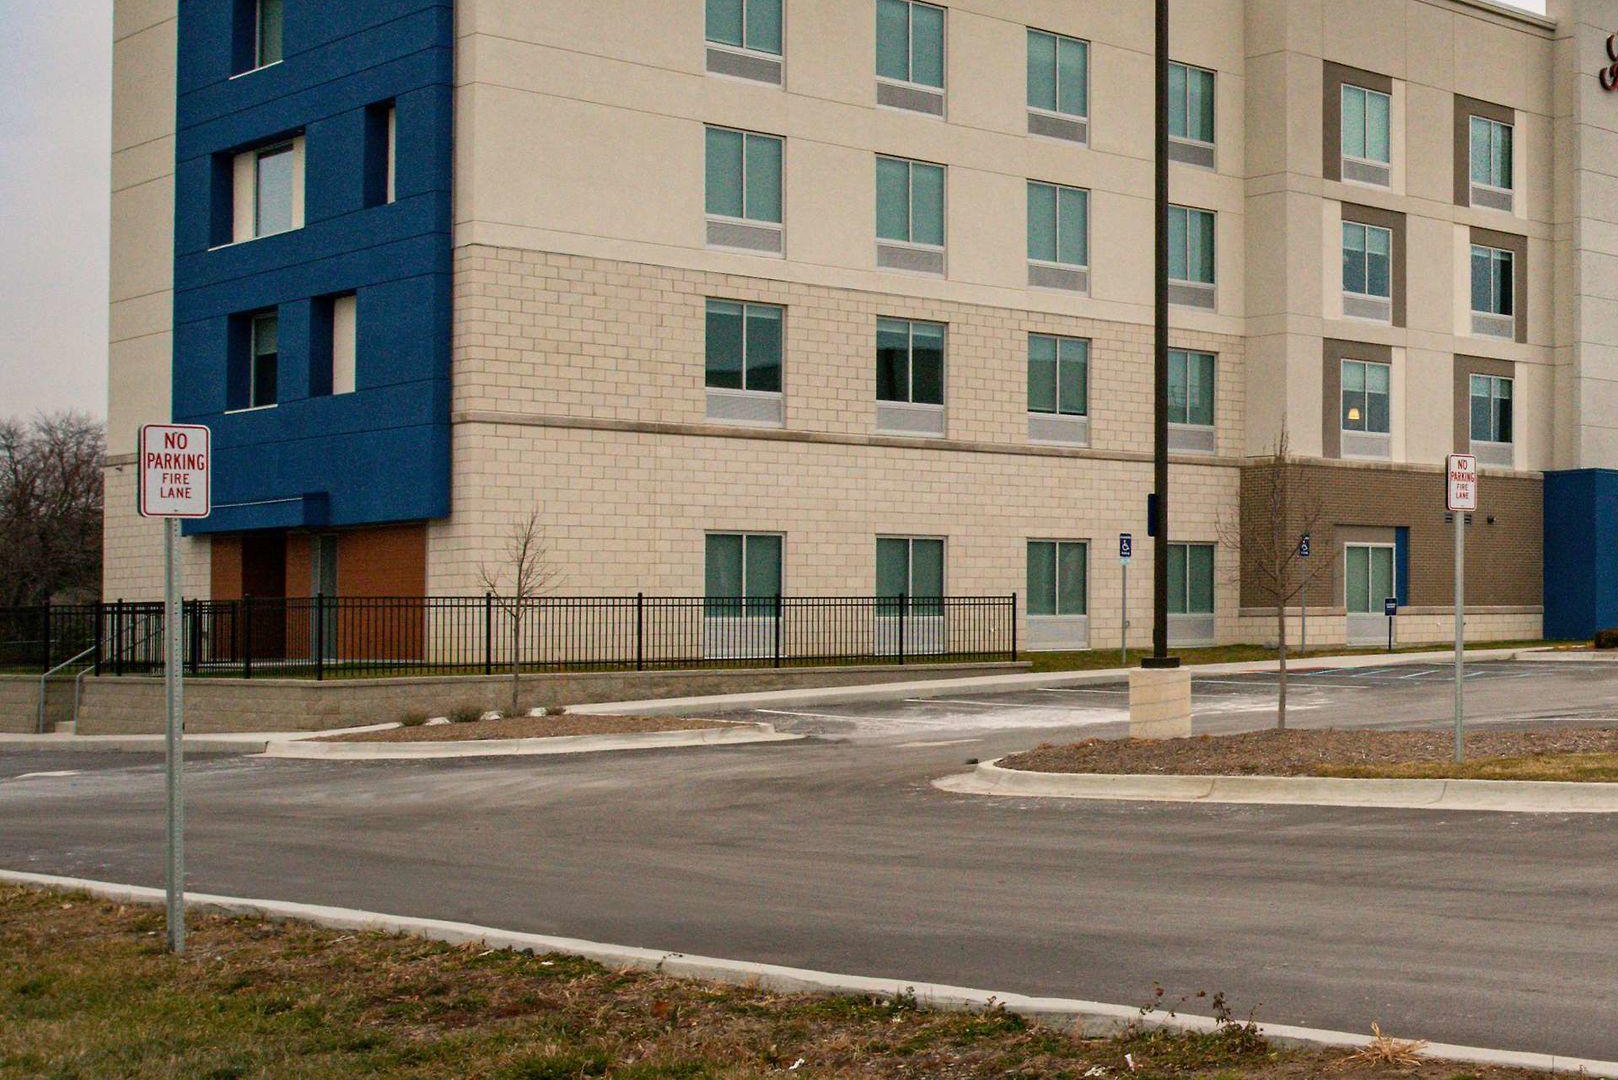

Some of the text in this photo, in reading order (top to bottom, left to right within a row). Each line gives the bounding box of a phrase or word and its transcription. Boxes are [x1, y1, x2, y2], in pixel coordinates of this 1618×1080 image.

[164, 432, 187, 450] NO
[147, 452, 206, 471] PARKING
[1457, 460, 1468, 470] NO
[162, 472, 190, 485] FIRE
[1451, 471, 1475, 482] PARKING
[160, 487, 192, 499] LANE
